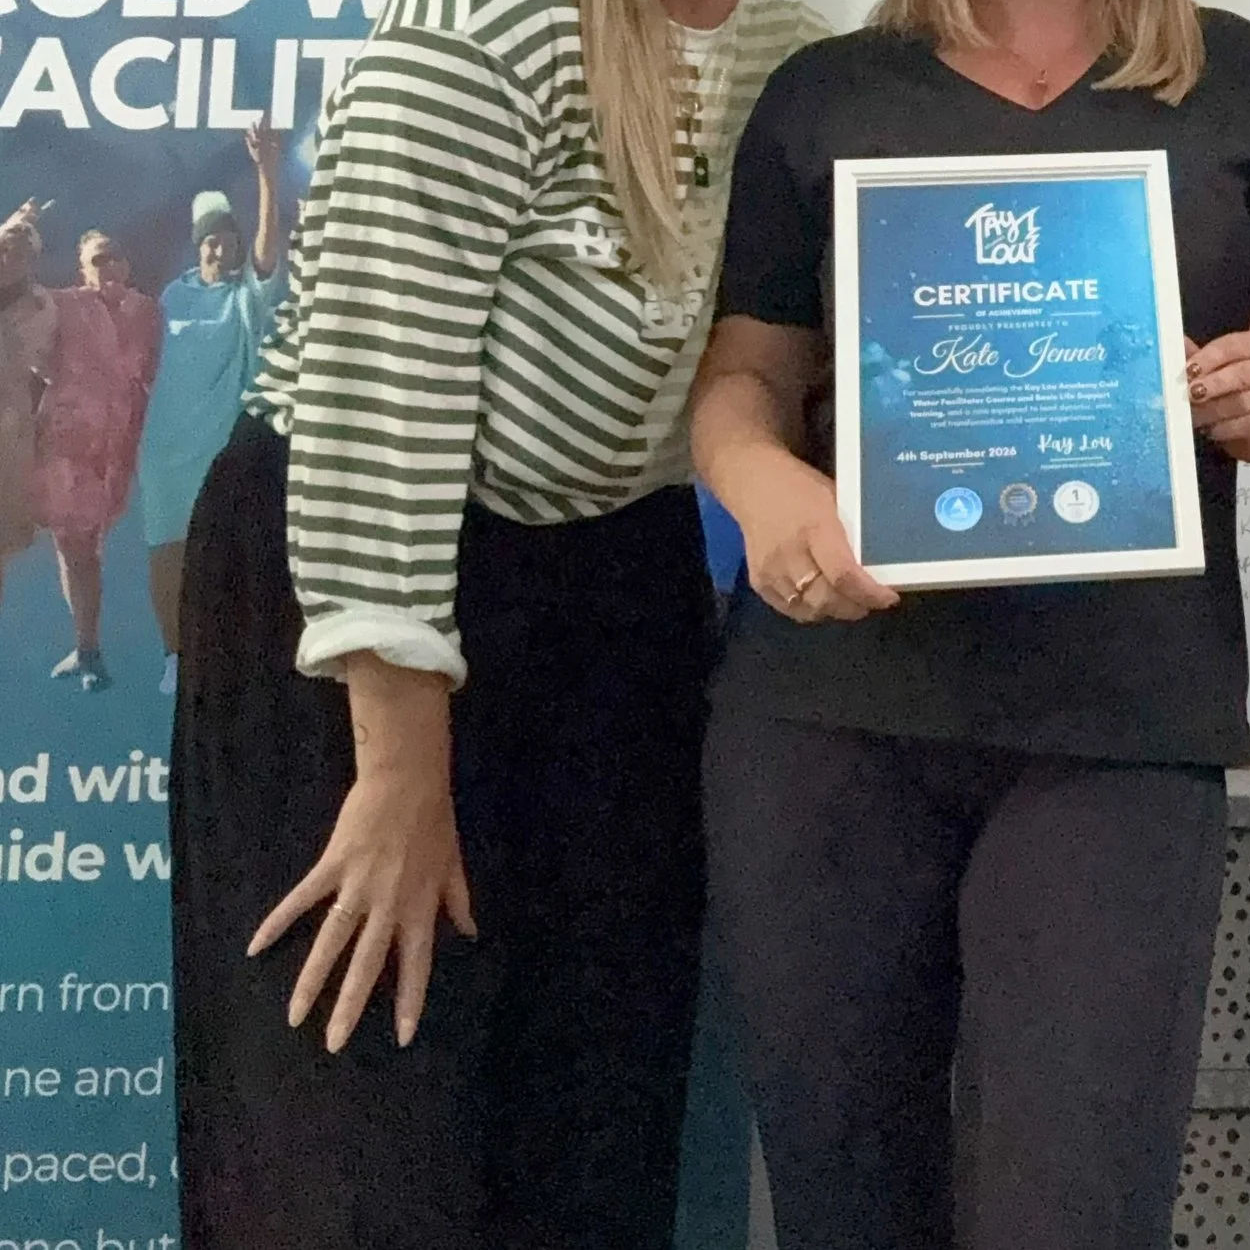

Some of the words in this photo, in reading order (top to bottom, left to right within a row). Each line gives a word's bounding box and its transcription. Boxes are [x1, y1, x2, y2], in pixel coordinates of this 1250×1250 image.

[0, 36, 367, 130] ACILIT
[914, 279, 1099, 306] CERTIFICATE
[914, 334, 999, 375] Kate
[1003, 332, 1108, 378] Jenner
[896, 450, 917, 462] 4th
[919, 448, 986, 462] September
[68, 749, 169, 802] wit
[0, 828, 105, 881] ide
[123, 843, 171, 880] w
[0, 982, 44, 1012] rn
[59, 972, 169, 1012] from
[74, 1056, 164, 1096] and
[3, 1141, 158, 1193] paced,
